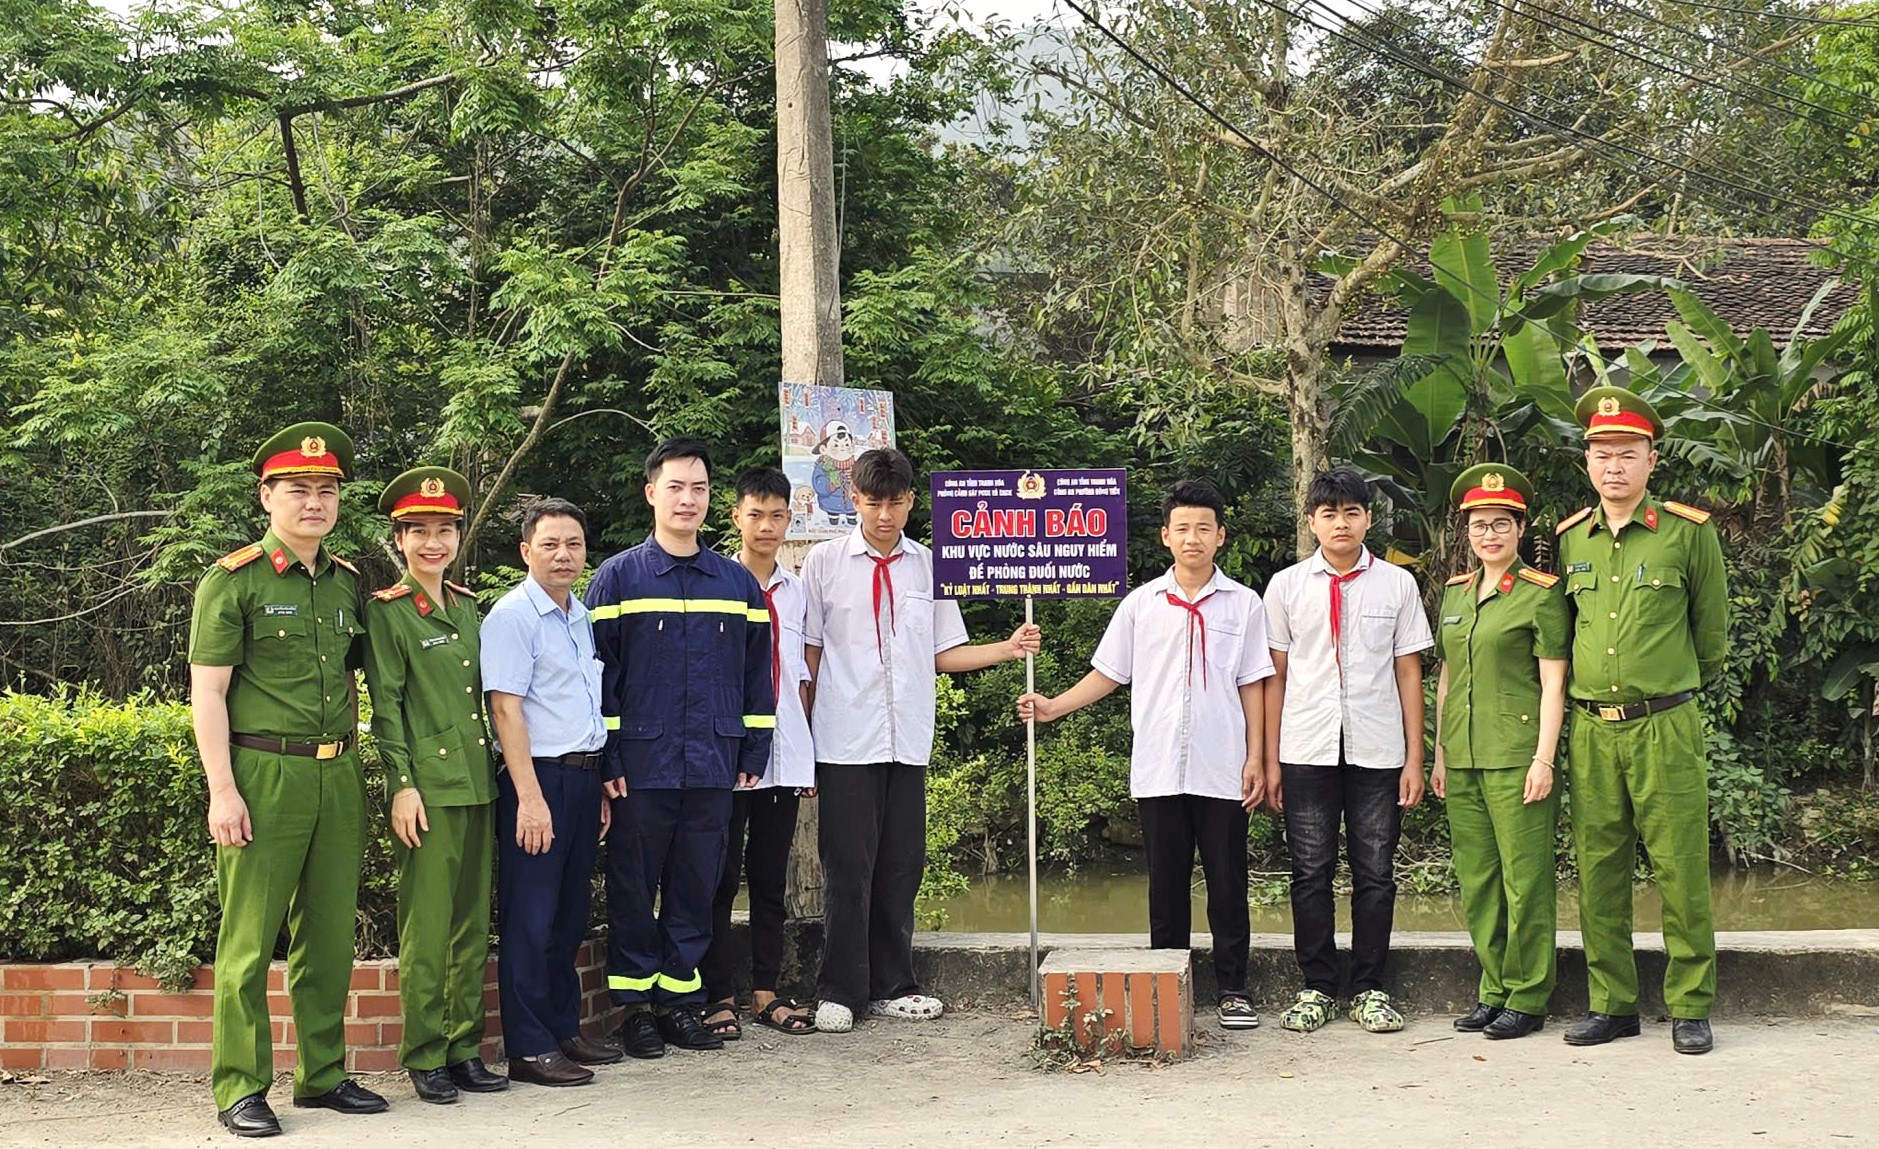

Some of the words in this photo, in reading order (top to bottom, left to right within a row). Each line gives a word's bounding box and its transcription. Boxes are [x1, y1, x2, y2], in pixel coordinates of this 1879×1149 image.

[951, 500, 1036, 539] CẢNH
[1044, 502, 1108, 538] BÁO
[942, 545, 966, 559] KHU
[968, 543, 991, 561] VỰC
[993, 541, 1025, 559] NƯỚC
[1027, 541, 1051, 558] SÂU
[1054, 543, 1085, 558] NGUY
[1087, 539, 1118, 557] HIỂM
[987, 563, 1026, 579] PHÒNG
[1028, 561, 1056, 579] ĐUỐI
[1058, 562, 1091, 578] NƯỚC
